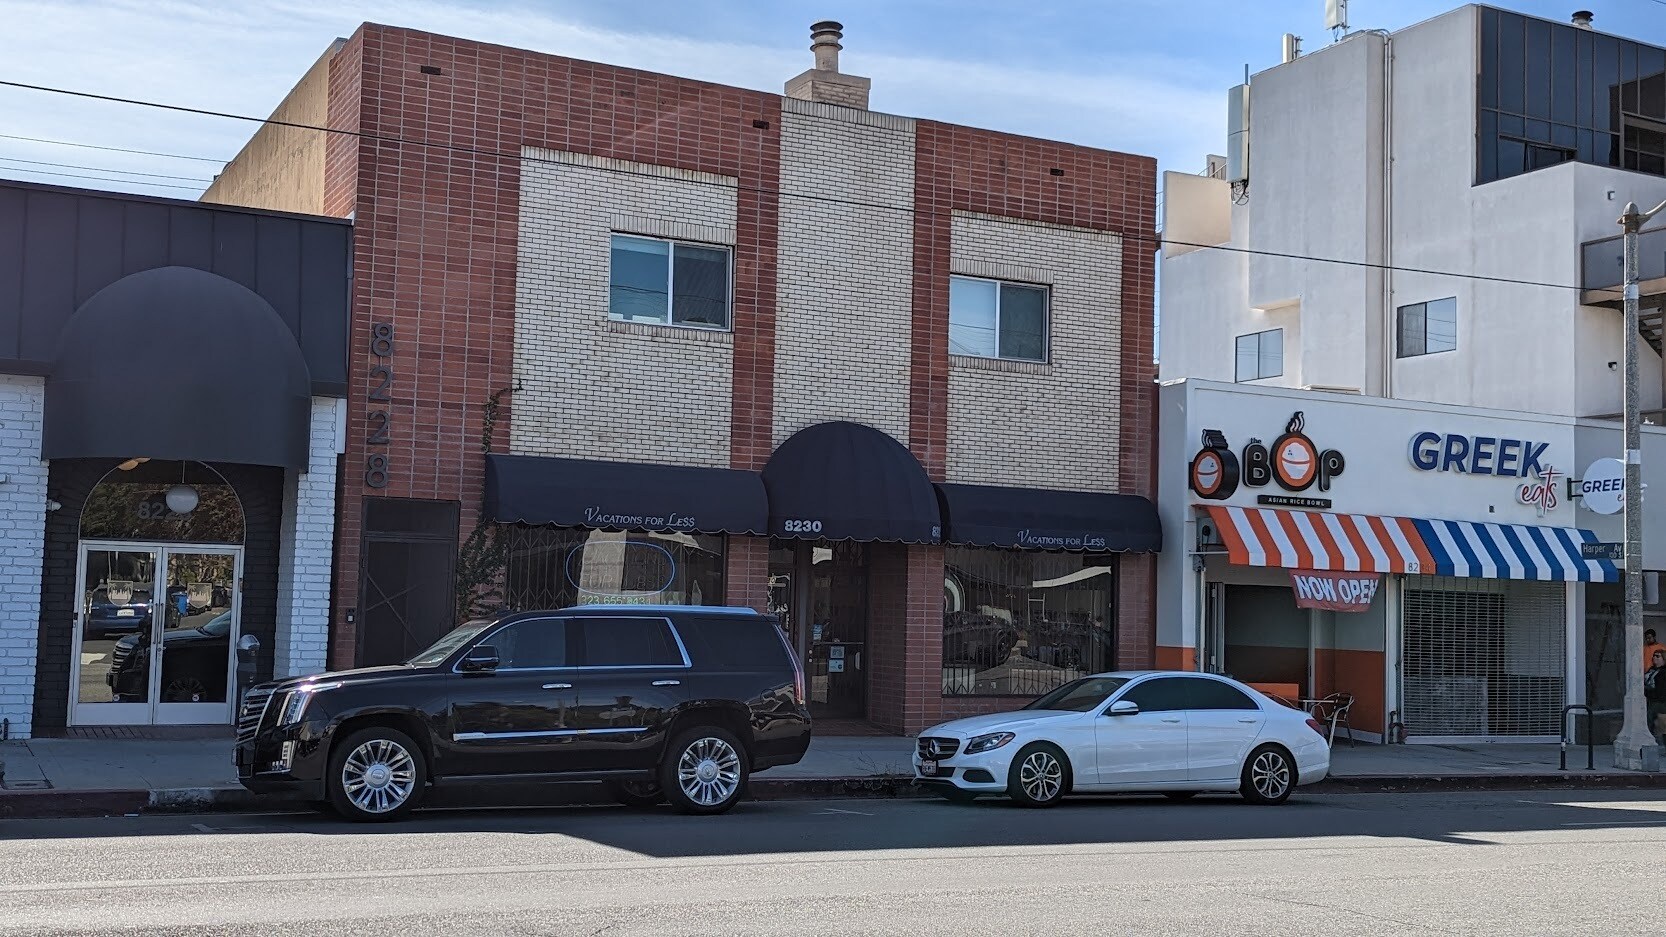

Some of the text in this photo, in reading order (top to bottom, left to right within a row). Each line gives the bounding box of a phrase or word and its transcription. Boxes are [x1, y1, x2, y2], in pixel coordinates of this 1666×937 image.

[365, 322, 393, 489] 8228
[1409, 431, 1550, 478] GREEK
[1307, 499, 1325, 507] BOWL
[1519, 465, 1563, 513] eats
[784, 519, 823, 533] 8230
[1582, 544, 1606, 554] Harper
[1293, 574, 1379, 604] NOW OPEN
